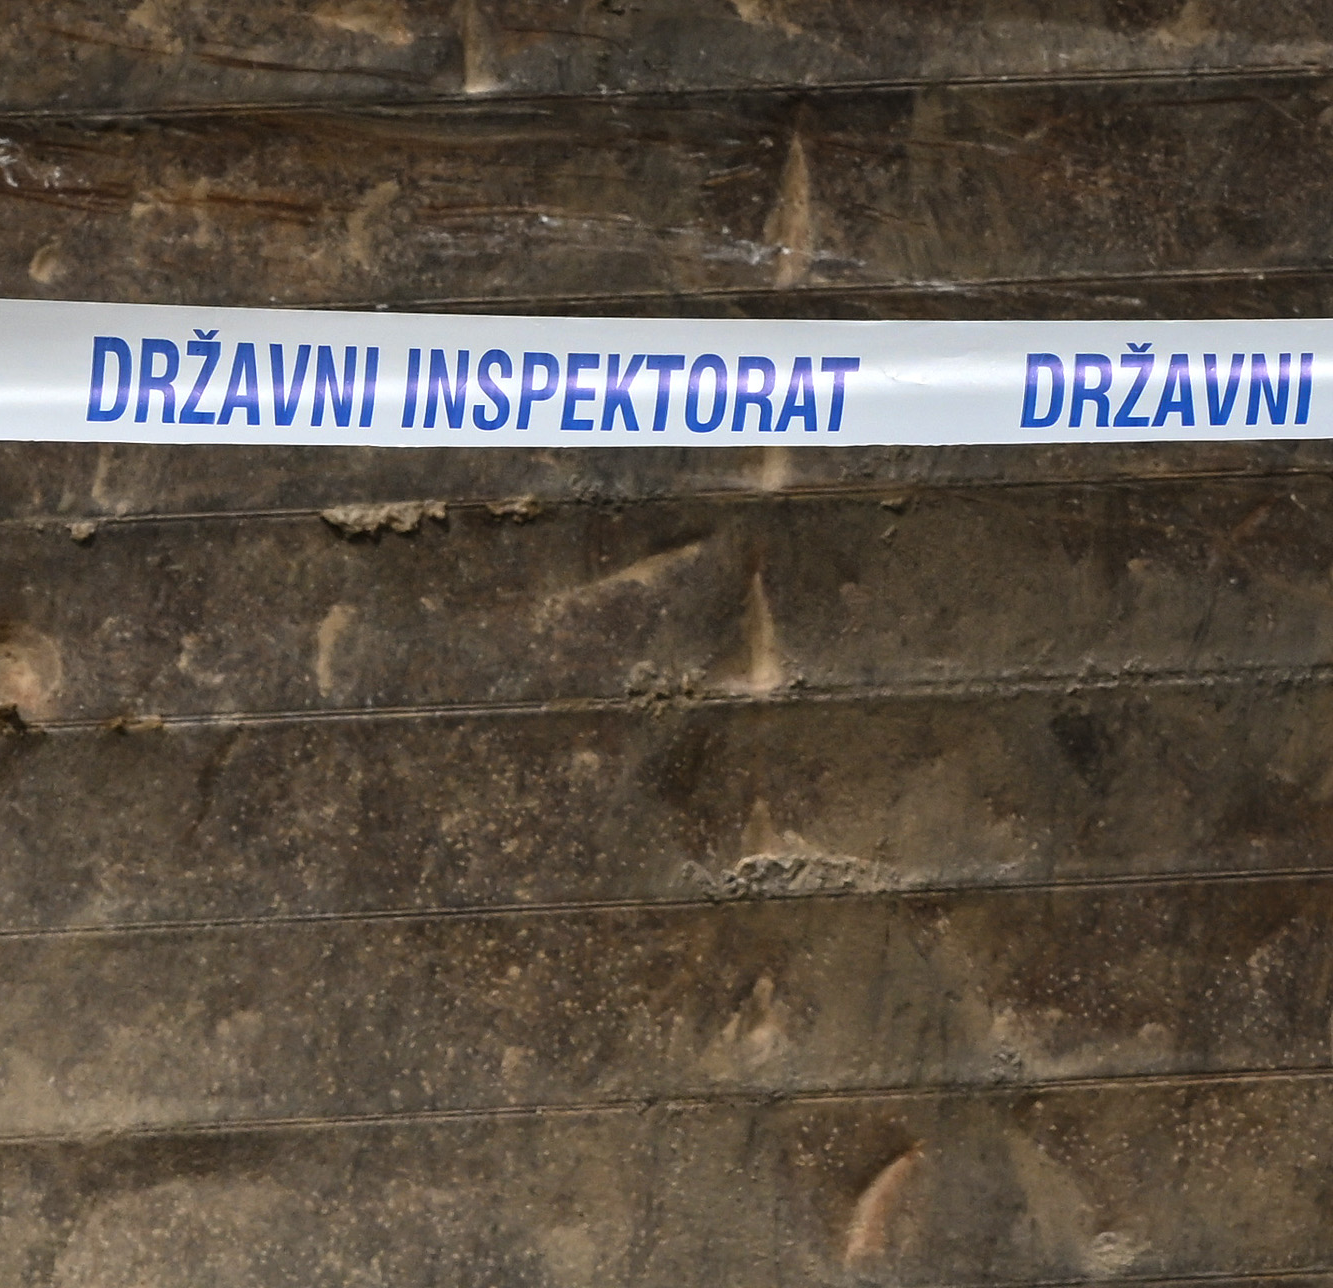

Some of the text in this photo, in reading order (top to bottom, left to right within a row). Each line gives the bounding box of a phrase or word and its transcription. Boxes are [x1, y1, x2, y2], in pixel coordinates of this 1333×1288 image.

[85, 328, 861, 434] DRŽAVNI INSPEKTORAT
[1019, 342, 1315, 429] DRŽAVNI
